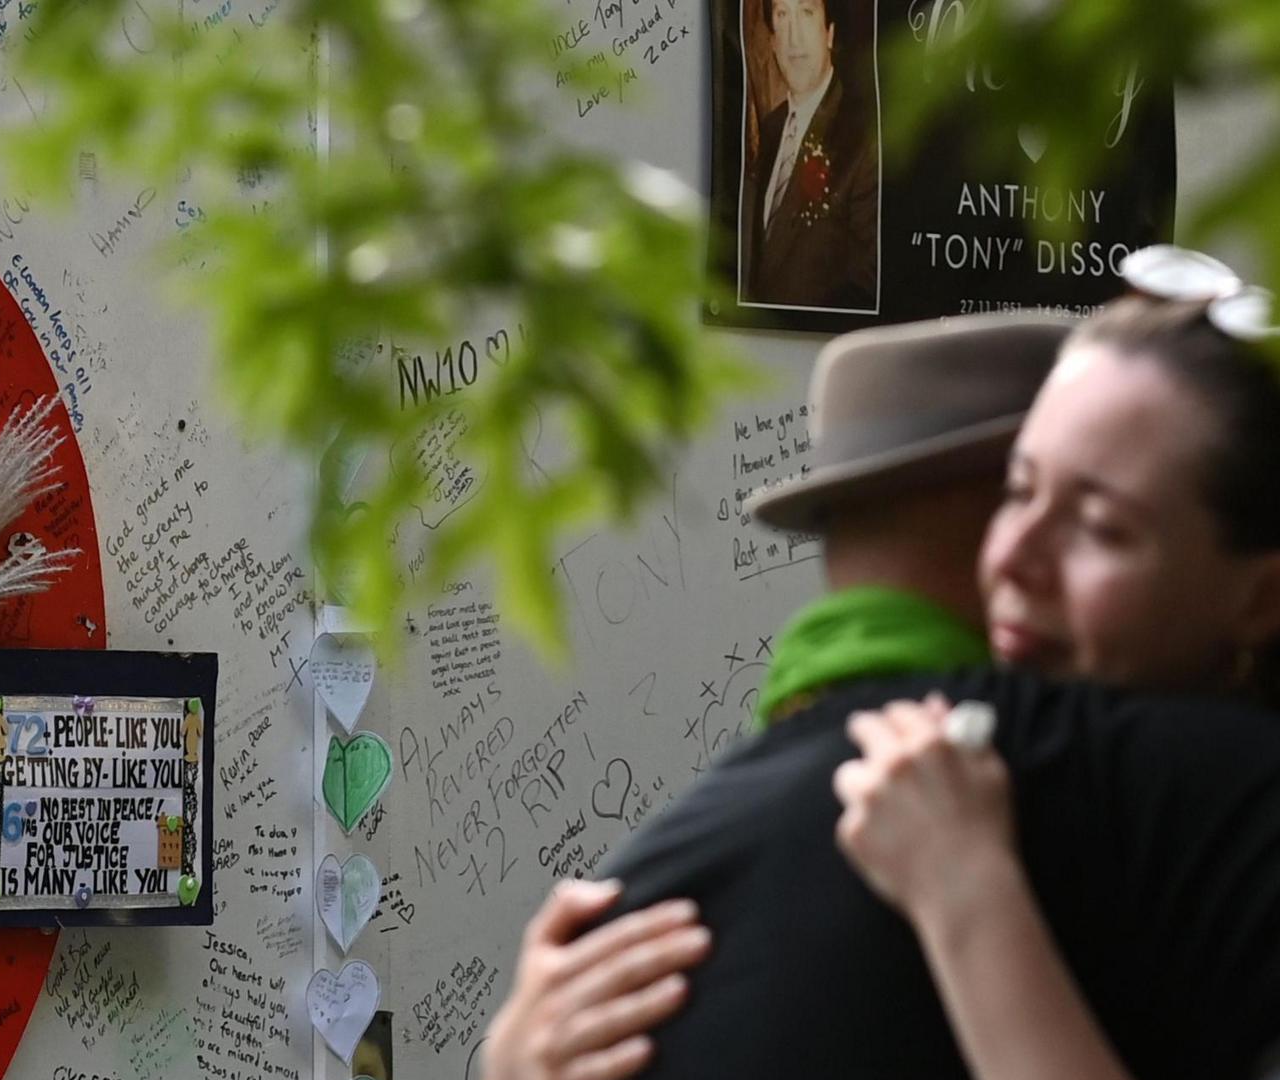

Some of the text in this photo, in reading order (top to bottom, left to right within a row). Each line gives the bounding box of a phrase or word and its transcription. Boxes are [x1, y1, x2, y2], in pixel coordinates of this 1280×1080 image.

[957, 182, 1105, 223] ANTHONY
[1037, 239, 1133, 277] DISSO
[397, 340, 478, 411] NW10
[734, 414, 774, 442] We love
[106, 457, 194, 557] God grant me
[116, 551, 140, 575] the
[194, 480, 209, 497] to
[126, 549, 166, 593] accept
[166, 555, 180, 571] I
[244, 562, 267, 584] can
[733, 536, 758, 572] Rest
[144, 551, 210, 624] cannot change
[154, 537, 250, 634] courage to change
[233, 592, 252, 620] and
[259, 589, 312, 640] difference
[240, 619, 254, 636] to
[153, 716, 182, 750] YOU
[399, 682, 502, 783] ALWAYS
[3, 752, 183, 788] GETTING YOU
[426, 717, 514, 827] REVERED
[521, 749, 566, 828] RIP
[414, 691, 589, 888] NEVER FORGOTTEN
[3, 797, 165, 842] 6 NO REST IN PEACE!
[42, 821, 121, 845] OUR VOICE
[26, 843, 129, 869] FOR JUSTICE
[0, 868, 168, 895] IS MANY LIKE YOU
[209, 957, 263, 987] Our hearts
[247, 989, 267, 1010] hold
